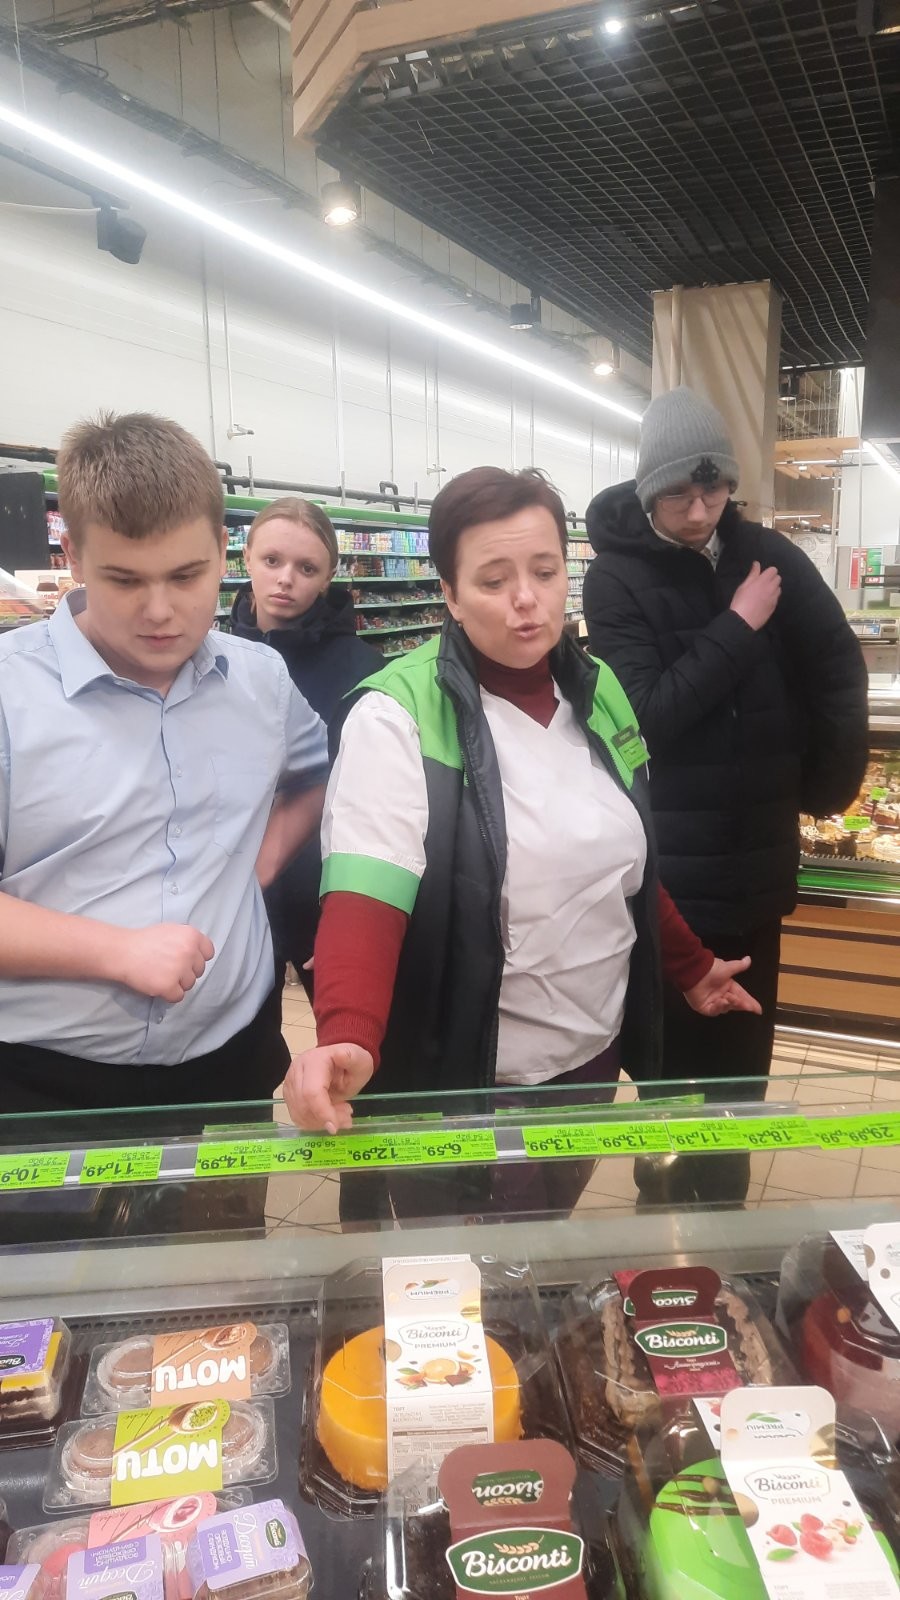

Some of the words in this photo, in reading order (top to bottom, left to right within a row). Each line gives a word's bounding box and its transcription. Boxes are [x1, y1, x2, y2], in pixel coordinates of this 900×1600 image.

[406, 1328, 462, 1339] Bisconti
[645, 1332, 720, 1349] Bisconti
[156, 1355, 247, 1392] MOTU
[116, 1439, 219, 1481] MOTU
[754, 1477, 822, 1492] Bisconti
[461, 1544, 572, 1577] Bisconti
